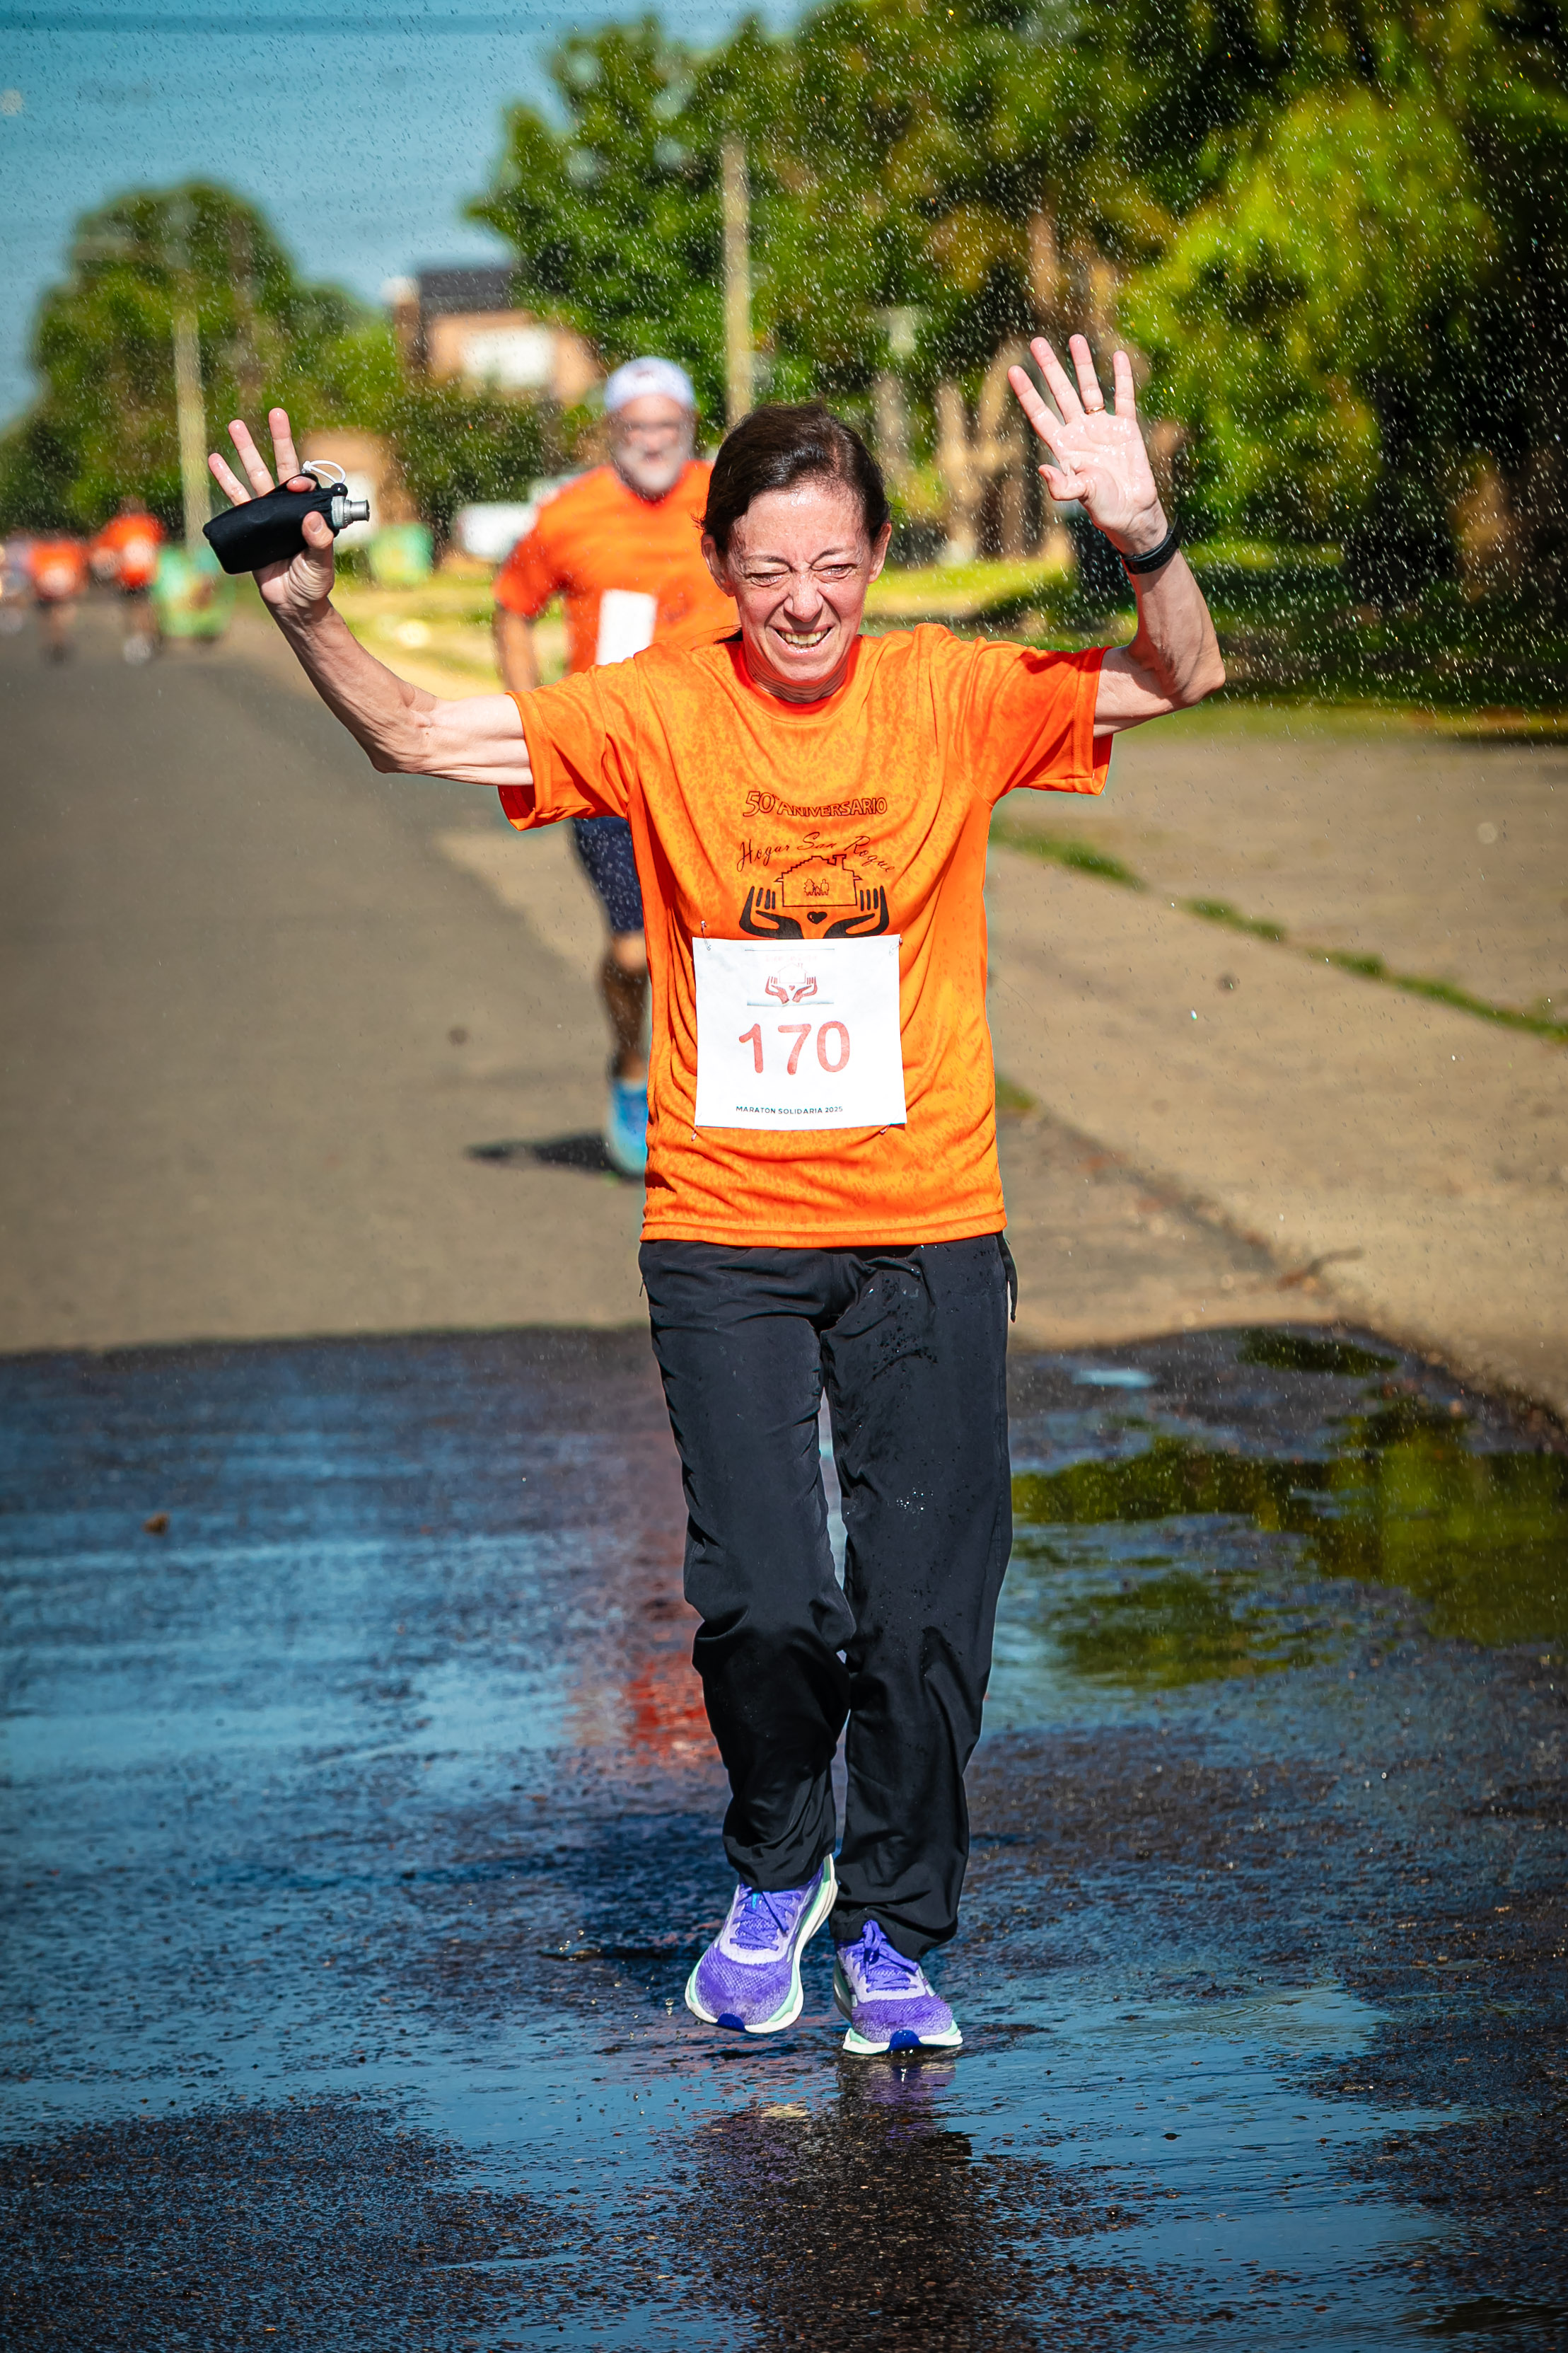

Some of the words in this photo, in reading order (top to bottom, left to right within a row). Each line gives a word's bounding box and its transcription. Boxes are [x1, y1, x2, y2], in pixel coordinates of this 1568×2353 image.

[777, 797, 888, 817] ANIVERSARIO
[736, 838, 790, 872] Hogar
[796, 831, 837, 850] San
[844, 836, 895, 872] Roque
[738, 1020, 850, 1075] 170
[736, 1106, 776, 1114] MARATON
